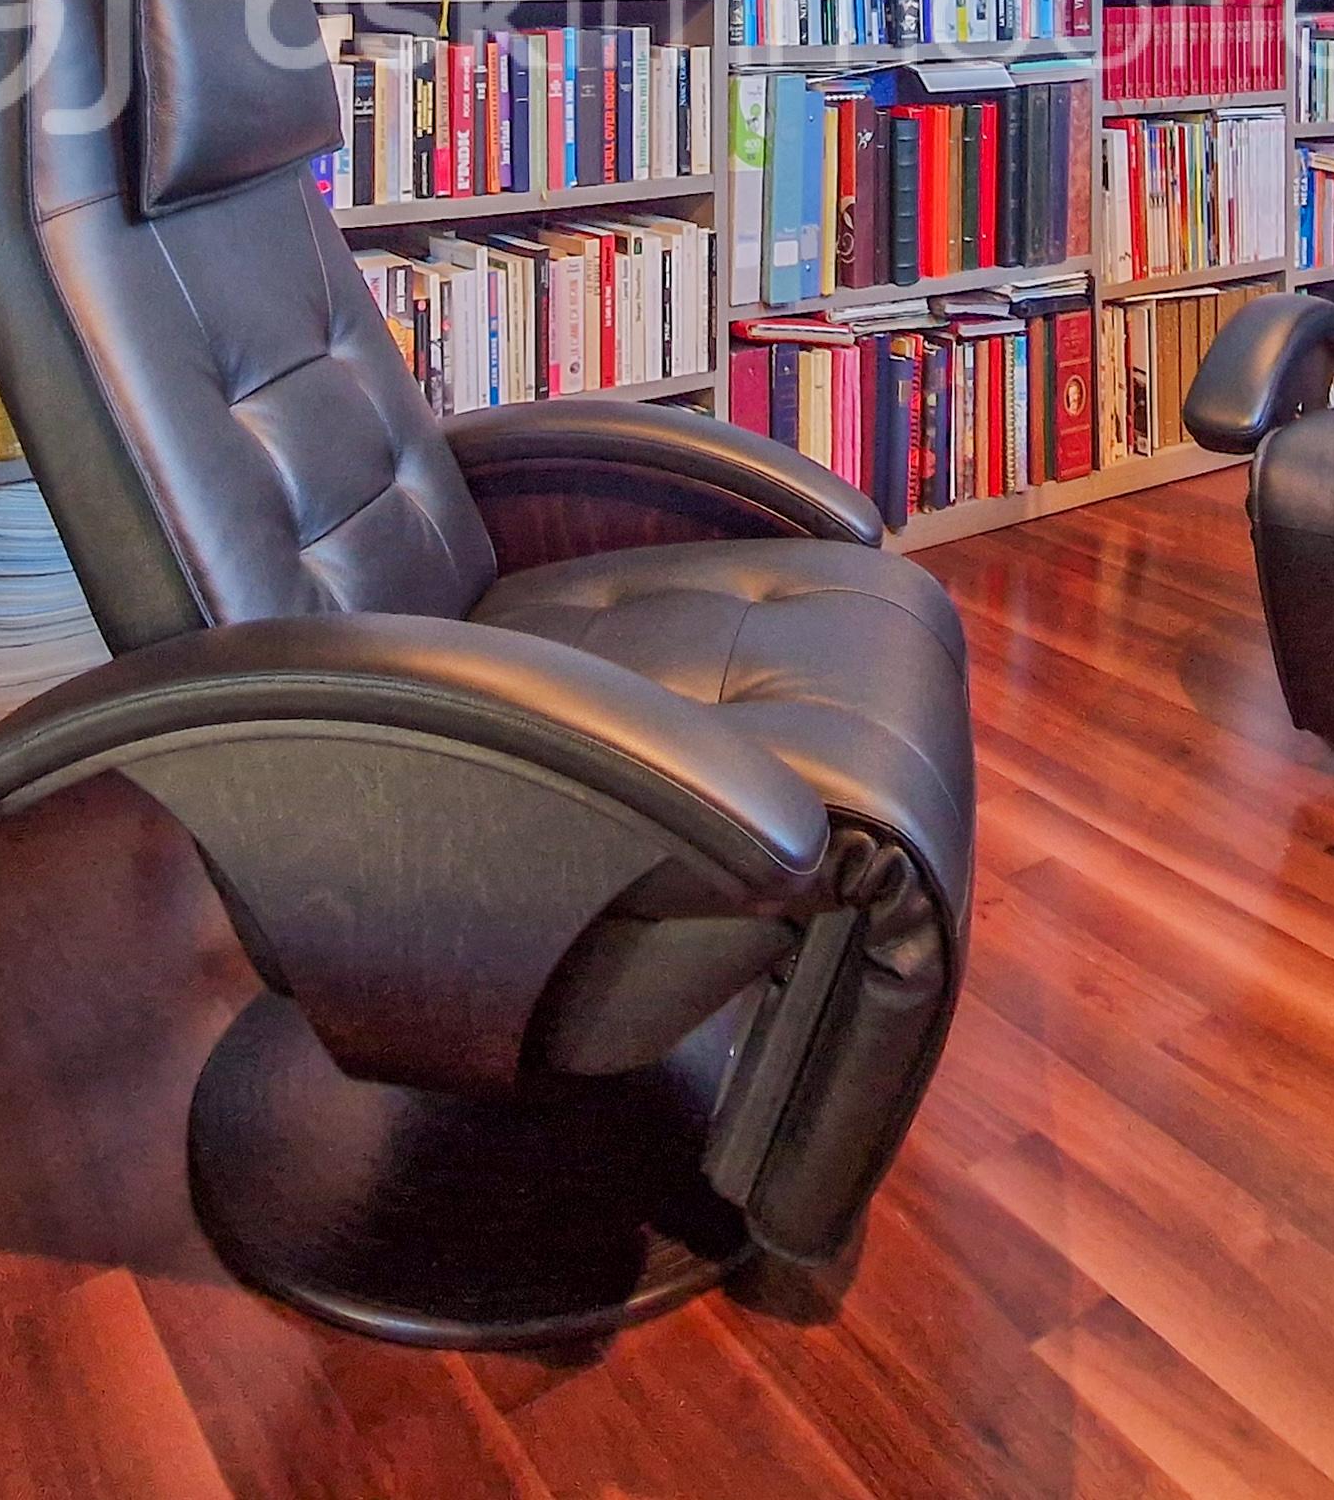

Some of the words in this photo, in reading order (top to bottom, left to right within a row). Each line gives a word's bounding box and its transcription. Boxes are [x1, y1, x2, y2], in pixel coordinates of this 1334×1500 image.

[637, 51, 647, 75] fille
[604, 70, 615, 108] ROUGE
[637, 77, 646, 96] ma
[463, 93, 471, 118] ROGER
[637, 101, 647, 127] sans
[604, 110, 615, 140] OVER
[604, 142, 615, 169] PULL
[637, 132, 648, 169] jamais
[604, 170, 615, 182] LE
